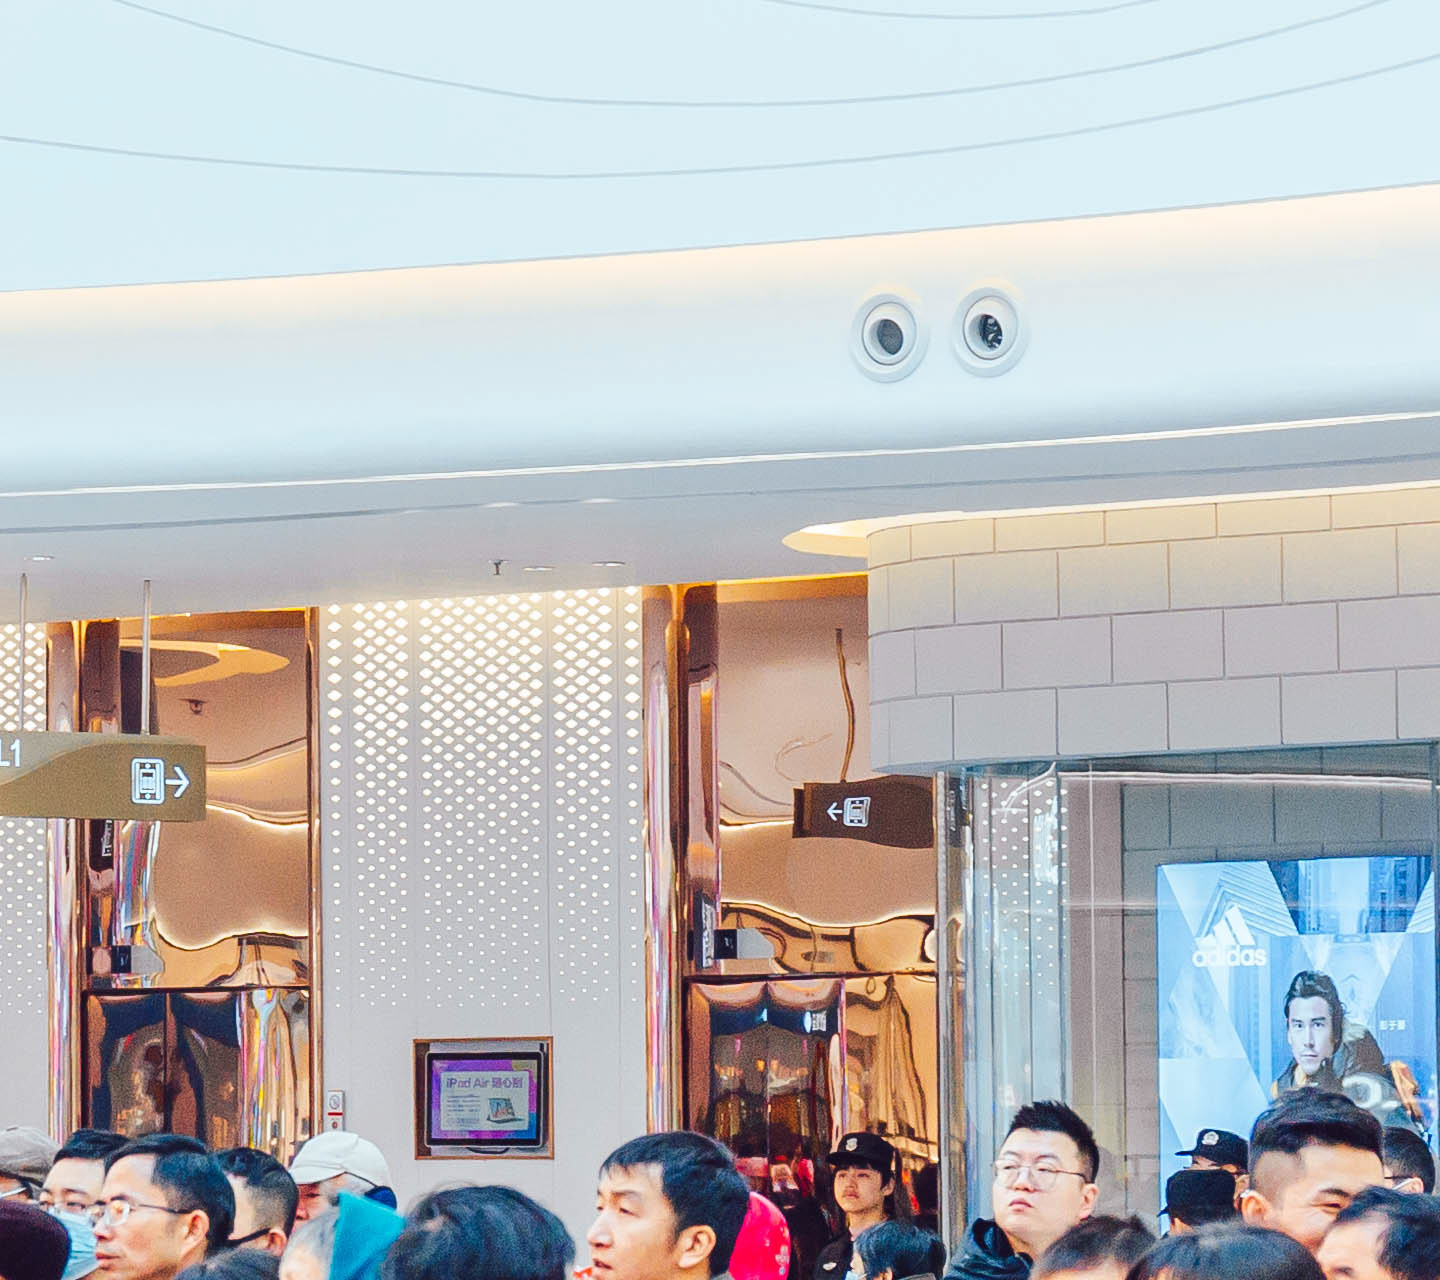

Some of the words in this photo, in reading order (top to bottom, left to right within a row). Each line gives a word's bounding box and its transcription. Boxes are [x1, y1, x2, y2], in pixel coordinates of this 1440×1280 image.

[1192, 946, 1267, 968] adidas
[446, 1077, 471, 1089] iPad
[473, 1077, 489, 1089] Air
